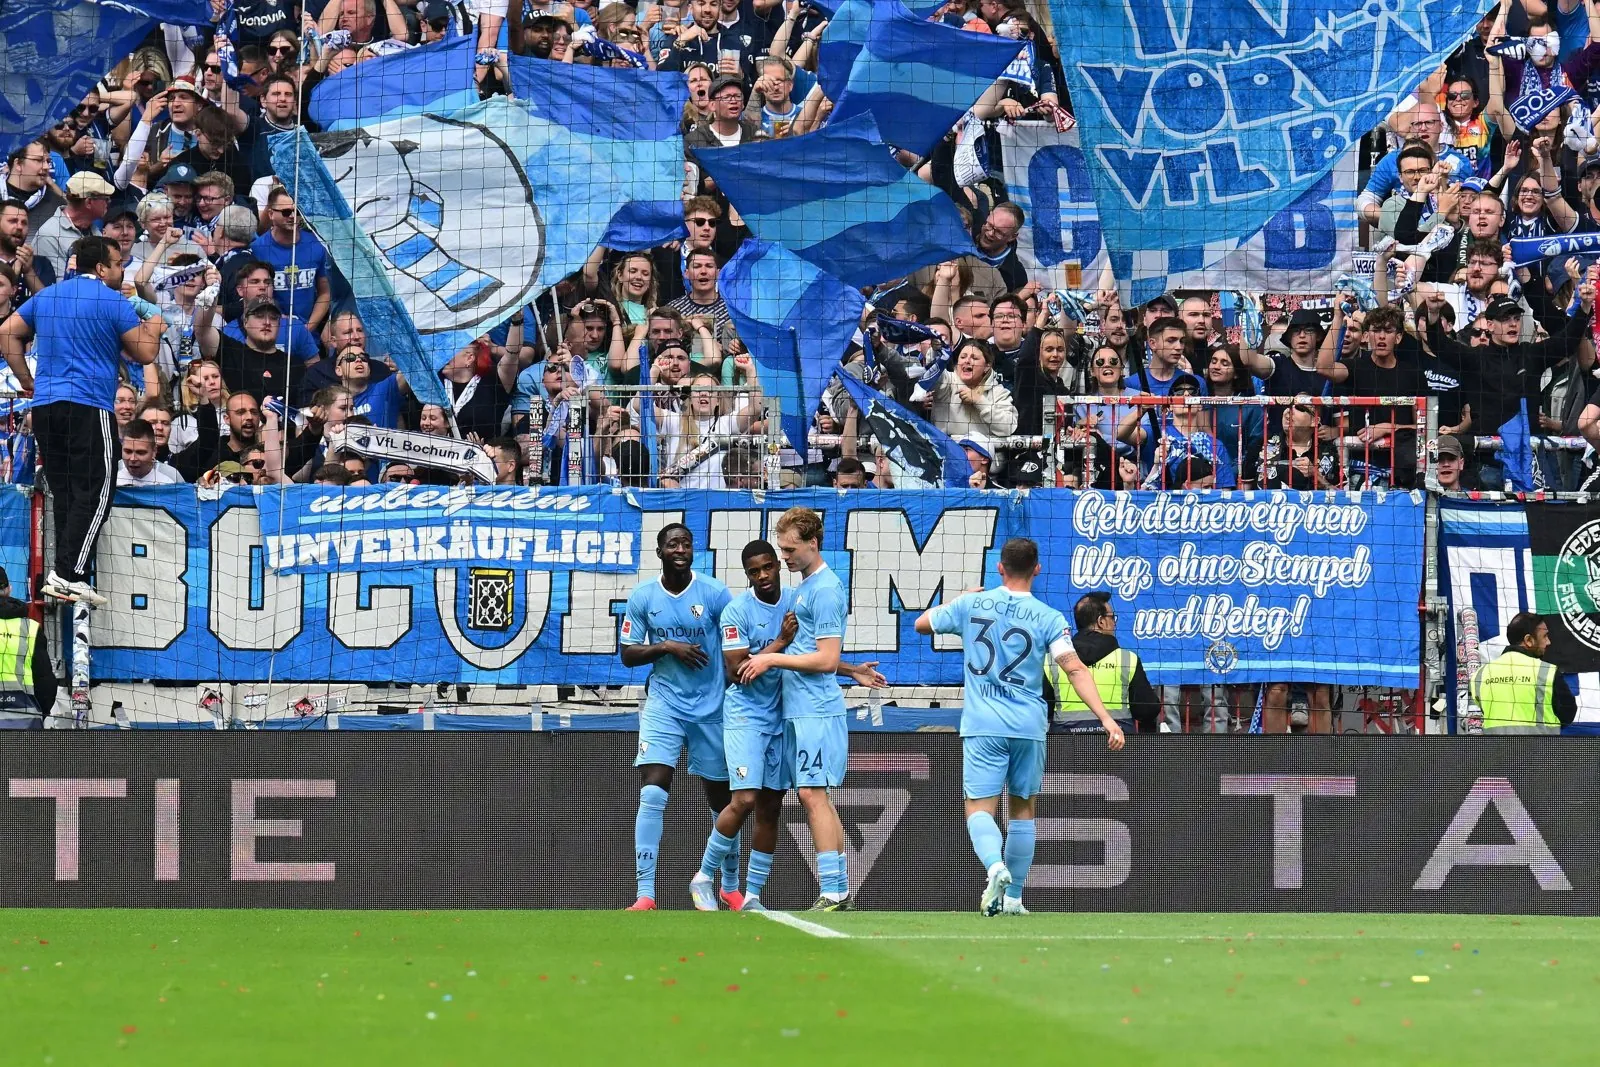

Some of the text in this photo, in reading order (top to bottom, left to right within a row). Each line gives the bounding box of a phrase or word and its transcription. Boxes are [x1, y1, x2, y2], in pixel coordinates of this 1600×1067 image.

[375, 435, 460, 460] VfL Bochum
[309, 484, 591, 516] unbequem
[1073, 490, 1142, 540] Geh
[1141, 492, 1251, 534] deinen
[265, 520, 633, 568] UNVERKÄUFLICH
[1071, 541, 1371, 600] Weg, ohne Stempel
[972, 597, 1041, 622] BOCHUM
[1134, 595, 1202, 639] und
[656, 627, 706, 638] ONOVIA
[967, 616, 1033, 686] 32
[798, 748, 824, 772] 24
[8, 778, 336, 881] TIE
